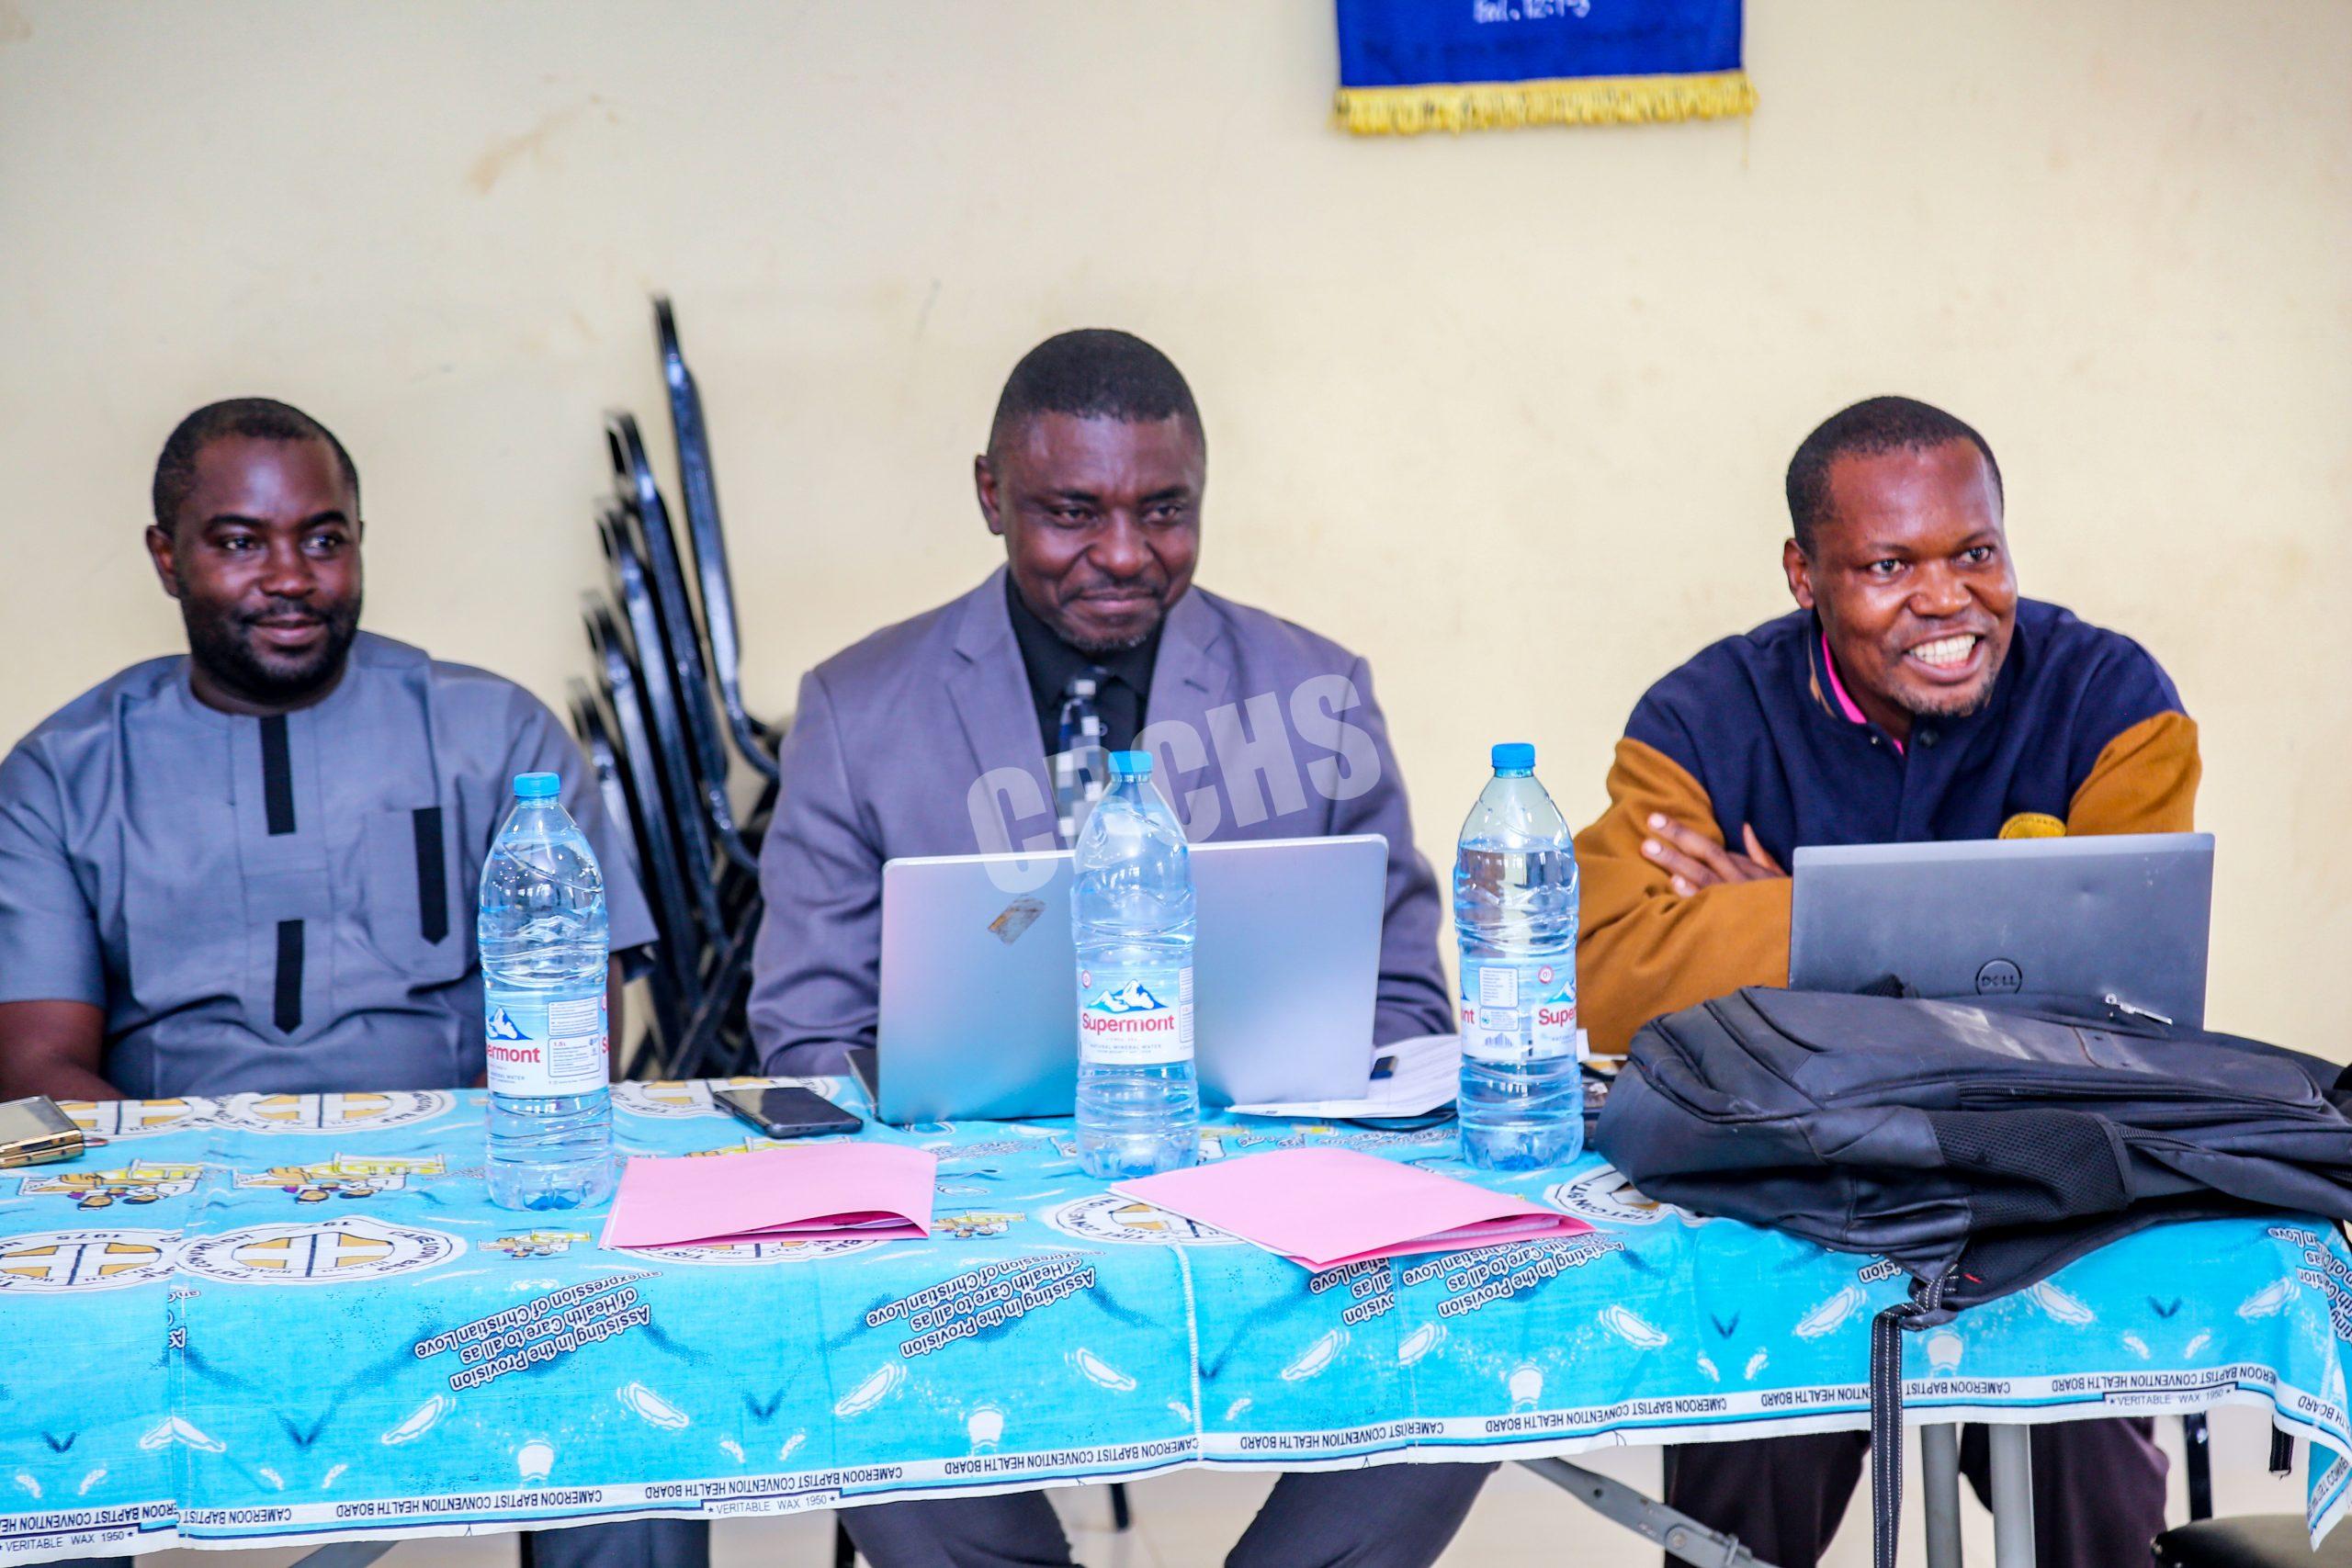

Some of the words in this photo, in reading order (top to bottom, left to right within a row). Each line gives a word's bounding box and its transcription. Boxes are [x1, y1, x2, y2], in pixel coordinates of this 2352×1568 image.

[1981, 975, 2018, 987] DELL
[1082, 1012, 1175, 1036] Supermont
[1065, 1258, 1080, 1273] of
[1509, 1247, 1543, 1267] Care
[1405, 1263, 1442, 1286] Love
[1491, 1259, 1507, 1274] to
[1537, 1260, 1556, 1277] in
[980, 1267, 997, 1284] of
[1013, 1265, 1063, 1291] Health
[1311, 1269, 1348, 1293] Love
[1448, 1275, 1468, 1291] as
[1470, 1266, 1487, 1288] all
[1512, 1268, 1537, 1288] the
[551, 1274, 637, 1304] expression
[617, 1289, 635, 1306] of
[908, 1273, 978, 1310] Christian
[975, 1283, 1012, 1304] Care
[1023, 1270, 1094, 1308] Assisting
[1353, 1282, 1371, 1297] as
[1439, 1278, 1512, 1316] Provision
[532, 1300, 548, 1316] of
[564, 1299, 616, 1325] Health
[867, 1303, 908, 1324] Love
[933, 1304, 953, 1325] all
[956, 1299, 974, 1314] to
[1003, 1302, 1023, 1316] in
[458, 1307, 529, 1341] Christian
[576, 1305, 649, 1344] Assisting
[911, 1314, 930, 1330] as
[977, 1307, 1003, 1326] the
[526, 1317, 563, 1338] Care
[416, 1336, 457, 1357] Love
[506, 1331, 525, 1346] to
[556, 1335, 573, 1351] in
[901, 1319, 976, 1357] Provision
[461, 1346, 481, 1361] as
[482, 1337, 503, 1359] all
[528, 1342, 556, 1361] the
[451, 1352, 527, 1389] Provision
[2200, 1367, 2238, 1383] BAPTIST
[1950, 1381, 2011, 1395] CAMEROON
[2051, 1377, 2086, 1392] BOARD
[2086, 1375, 2129, 1390] HEALTH
[2131, 1372, 2199, 1387] CONVENTION
[1794, 1388, 1836, 1404] HEALTH
[1905, 1382, 1948, 1396] BAPTIST
[2116, 1394, 2172, 1405] VERITABLE
[2177, 1393, 2202, 1403] WAX
[2205, 1388, 2223, 1401] 1950
[1631, 1400, 1672, 1416] BAPTIST
[1674, 1398, 1727, 1415] CAMEROON
[1760, 1392, 1793, 1407] BOARD
[1523, 1413, 1564, 1428] HEALTH
[1566, 1404, 1630, 1423] CONVENTION
[1485, 1417, 1521, 1433] BOARD
[1239, 1436, 1278, 1450] BOARD
[1279, 1435, 1320, 1450] HEALTH
[1322, 1427, 1386, 1448] CONVENTION
[1096, 1446, 1140, 1461] BAPTIST
[1140, 1438, 1199, 1455] CAMEROON
[944, 1460, 982, 1474] BOARD
[983, 1456, 1025, 1472] HEALTH
[1027, 1450, 1094, 1468] CONVENTION
[797, 1472, 841, 1489] BAPTIST
[842, 1467, 903, 1484] CAMEROON
[644, 1484, 683, 1500] BOARD
[684, 1481, 727, 1497] HEALTH
[729, 1475, 796, 1494] CONVENTION
[422, 1495, 492, 1512] CONVENTION
[493, 1492, 539, 1508] BAPTIST
[541, 1489, 603, 1506] CAMEROON
[716, 1501, 770, 1516] VERITABLE
[776, 1498, 800, 1511] WAX
[805, 1494, 828, 1506] 1950
[92, 1506, 139, 1524] BAPTIST
[228, 1507, 292, 1525] CAMEROON
[335, 1503, 375, 1518] BOARD
[377, 1499, 420, 1516] HEALTH
[17, 1512, 92, 1527] CONVENTION
[184, 1509, 227, 1525] BAPTIST
[5, 1537, 63, 1551] VERITABLE
[70, 1534, 96, 1544] WAX
[101, 1531, 125, 1541] 1950
